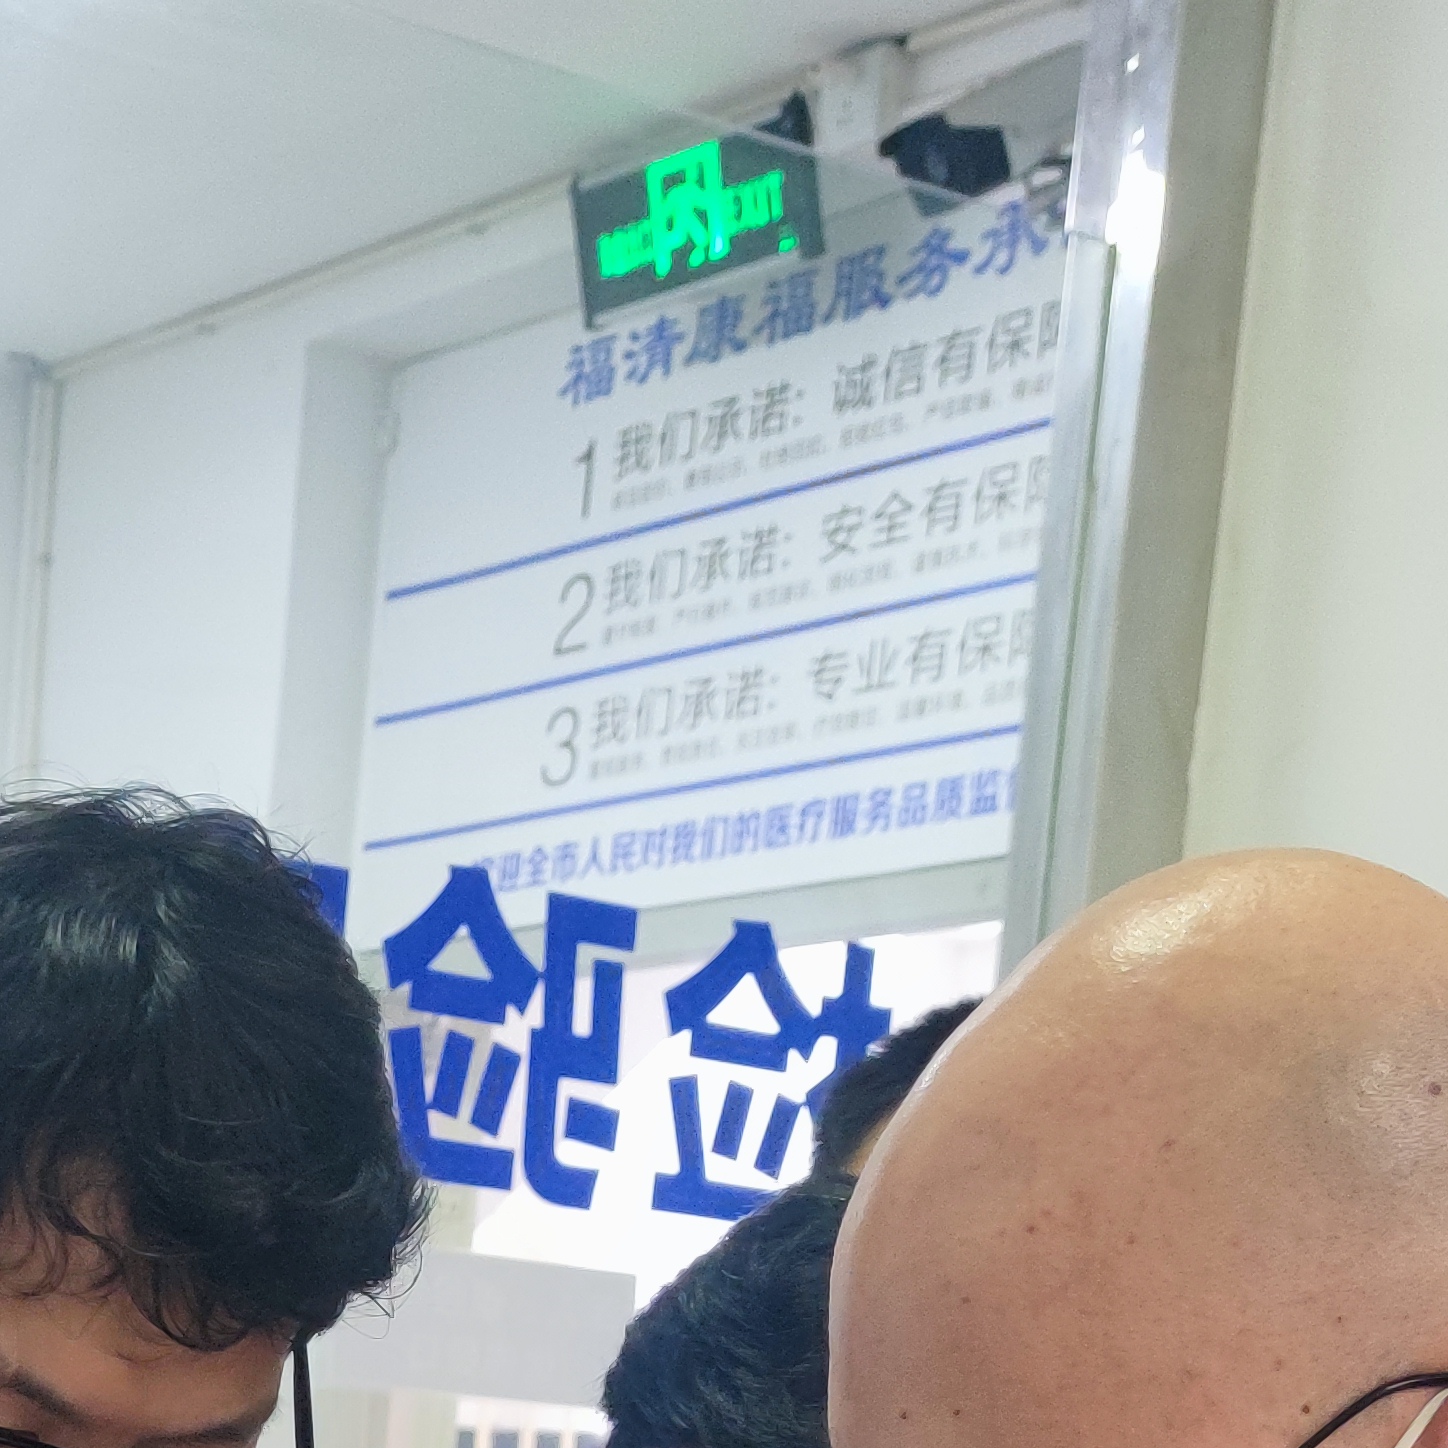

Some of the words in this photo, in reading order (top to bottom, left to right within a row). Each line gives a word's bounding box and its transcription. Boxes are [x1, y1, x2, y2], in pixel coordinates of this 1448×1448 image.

[558, 198, 1066, 407] 福清康福服务承
[574, 441, 596, 518] 1
[554, 572, 595, 657] 2
[540, 705, 582, 789] 3
[473, 767, 1020, 893] 迎全市人民对我们的医疗服务品质监
